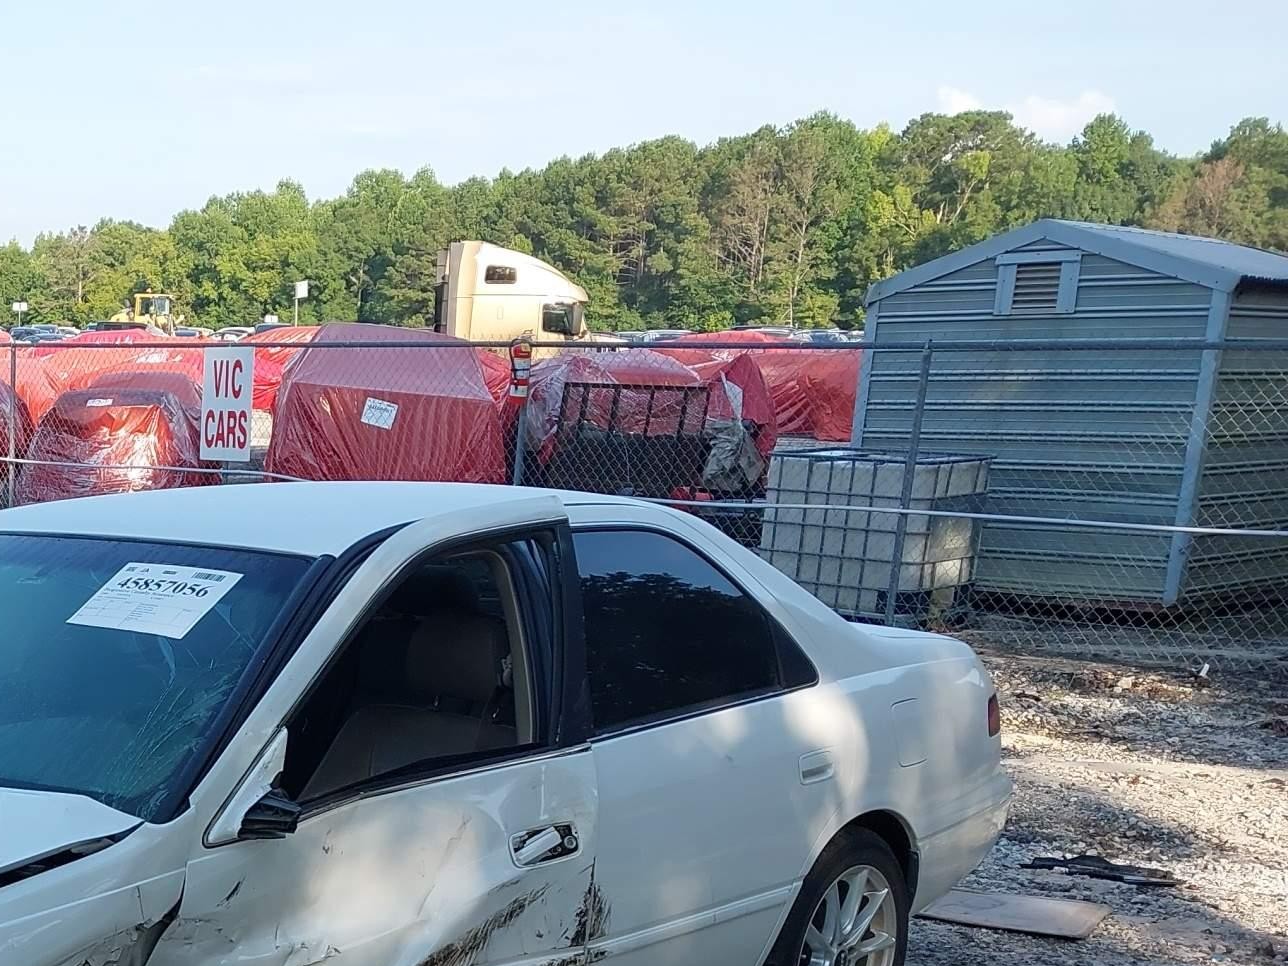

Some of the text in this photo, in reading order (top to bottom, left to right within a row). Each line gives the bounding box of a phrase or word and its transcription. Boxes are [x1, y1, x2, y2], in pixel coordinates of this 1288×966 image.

[214, 359, 243, 399] VIC
[205, 409, 247, 449] CARS
[117, 576, 214, 598] 45857056
